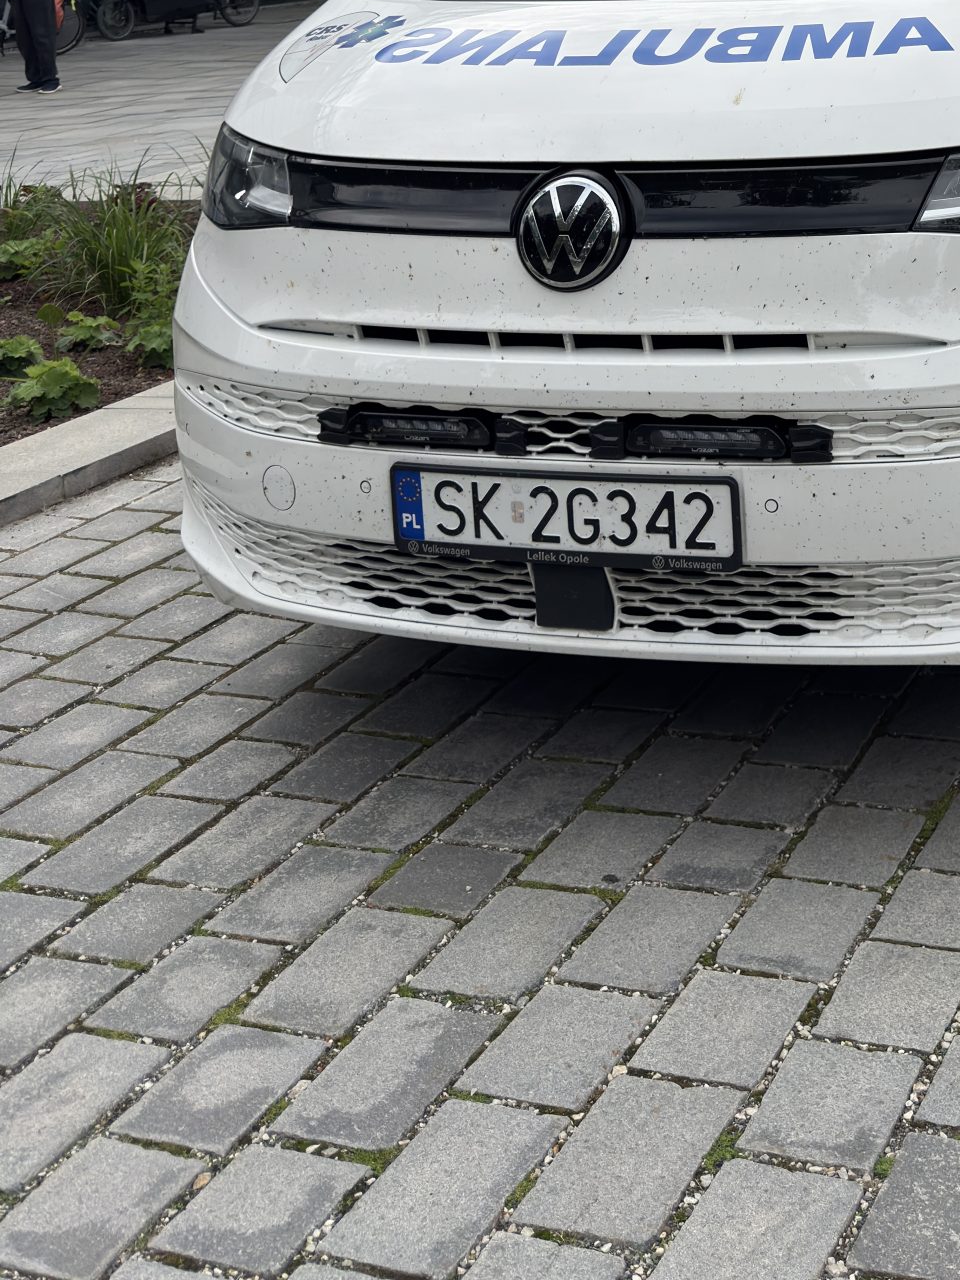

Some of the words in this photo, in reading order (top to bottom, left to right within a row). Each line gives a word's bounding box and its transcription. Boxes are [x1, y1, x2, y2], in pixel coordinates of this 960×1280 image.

[402, 513, 421, 529] PL
[434, 479, 504, 540] SK
[529, 484, 716, 552] 2G342
[422, 543, 471, 557] Volkswagen
[527, 550, 557, 562] Lellek
[559, 553, 589, 564] Opole
[668, 558, 723, 571] Volkswagen
